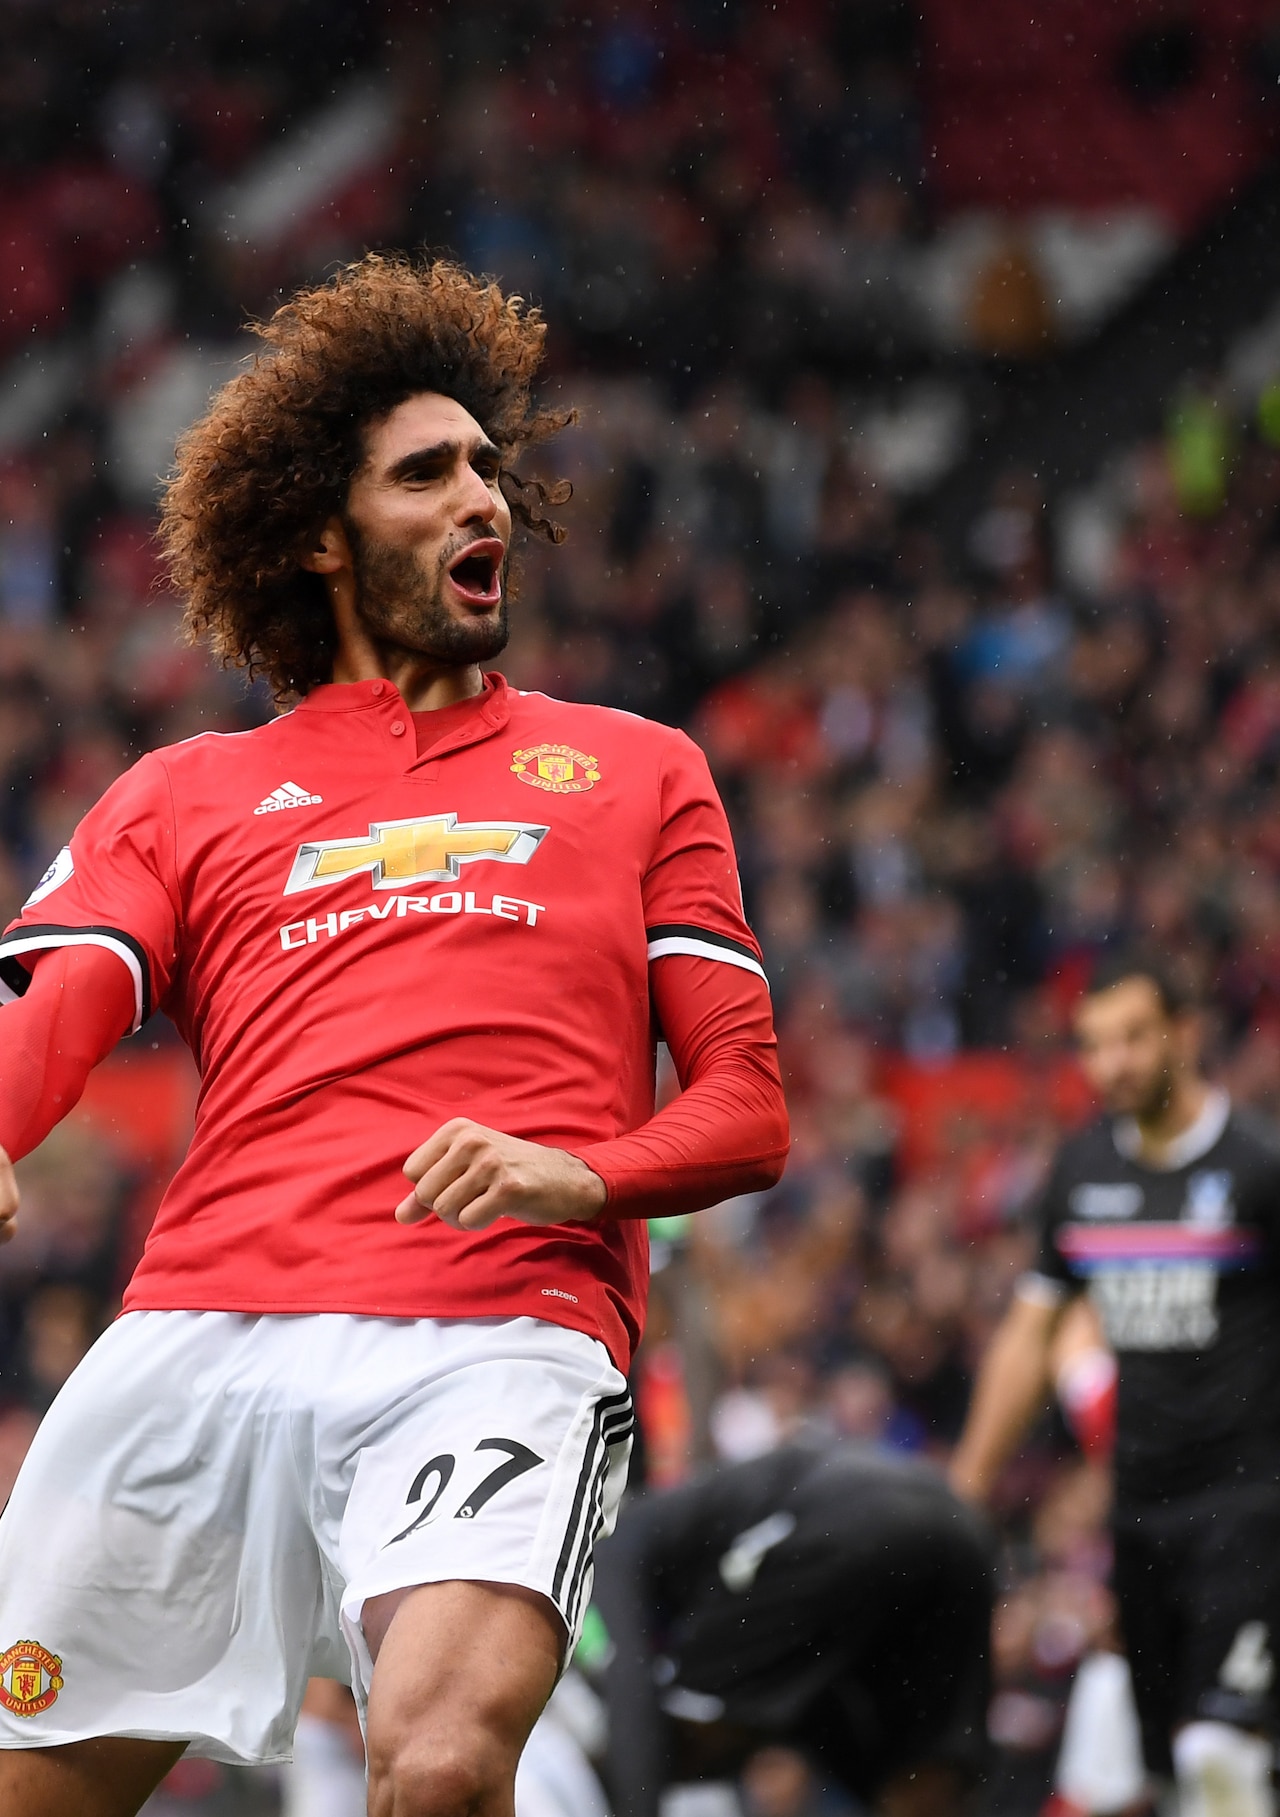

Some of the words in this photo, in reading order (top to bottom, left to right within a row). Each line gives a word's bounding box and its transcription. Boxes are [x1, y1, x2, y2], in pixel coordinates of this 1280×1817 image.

[520, 746, 591, 767] MANCHESTER
[531, 779, 581, 790] UNITED
[253, 795, 323, 816] adidas
[279, 891, 546, 951] CHEVROLET
[541, 1288, 579, 1304] adizero
[380, 1437, 545, 1551] 27
[0, 1646, 56, 1672] MANCHESTER
[6, 1697, 47, 1711] UNITED
